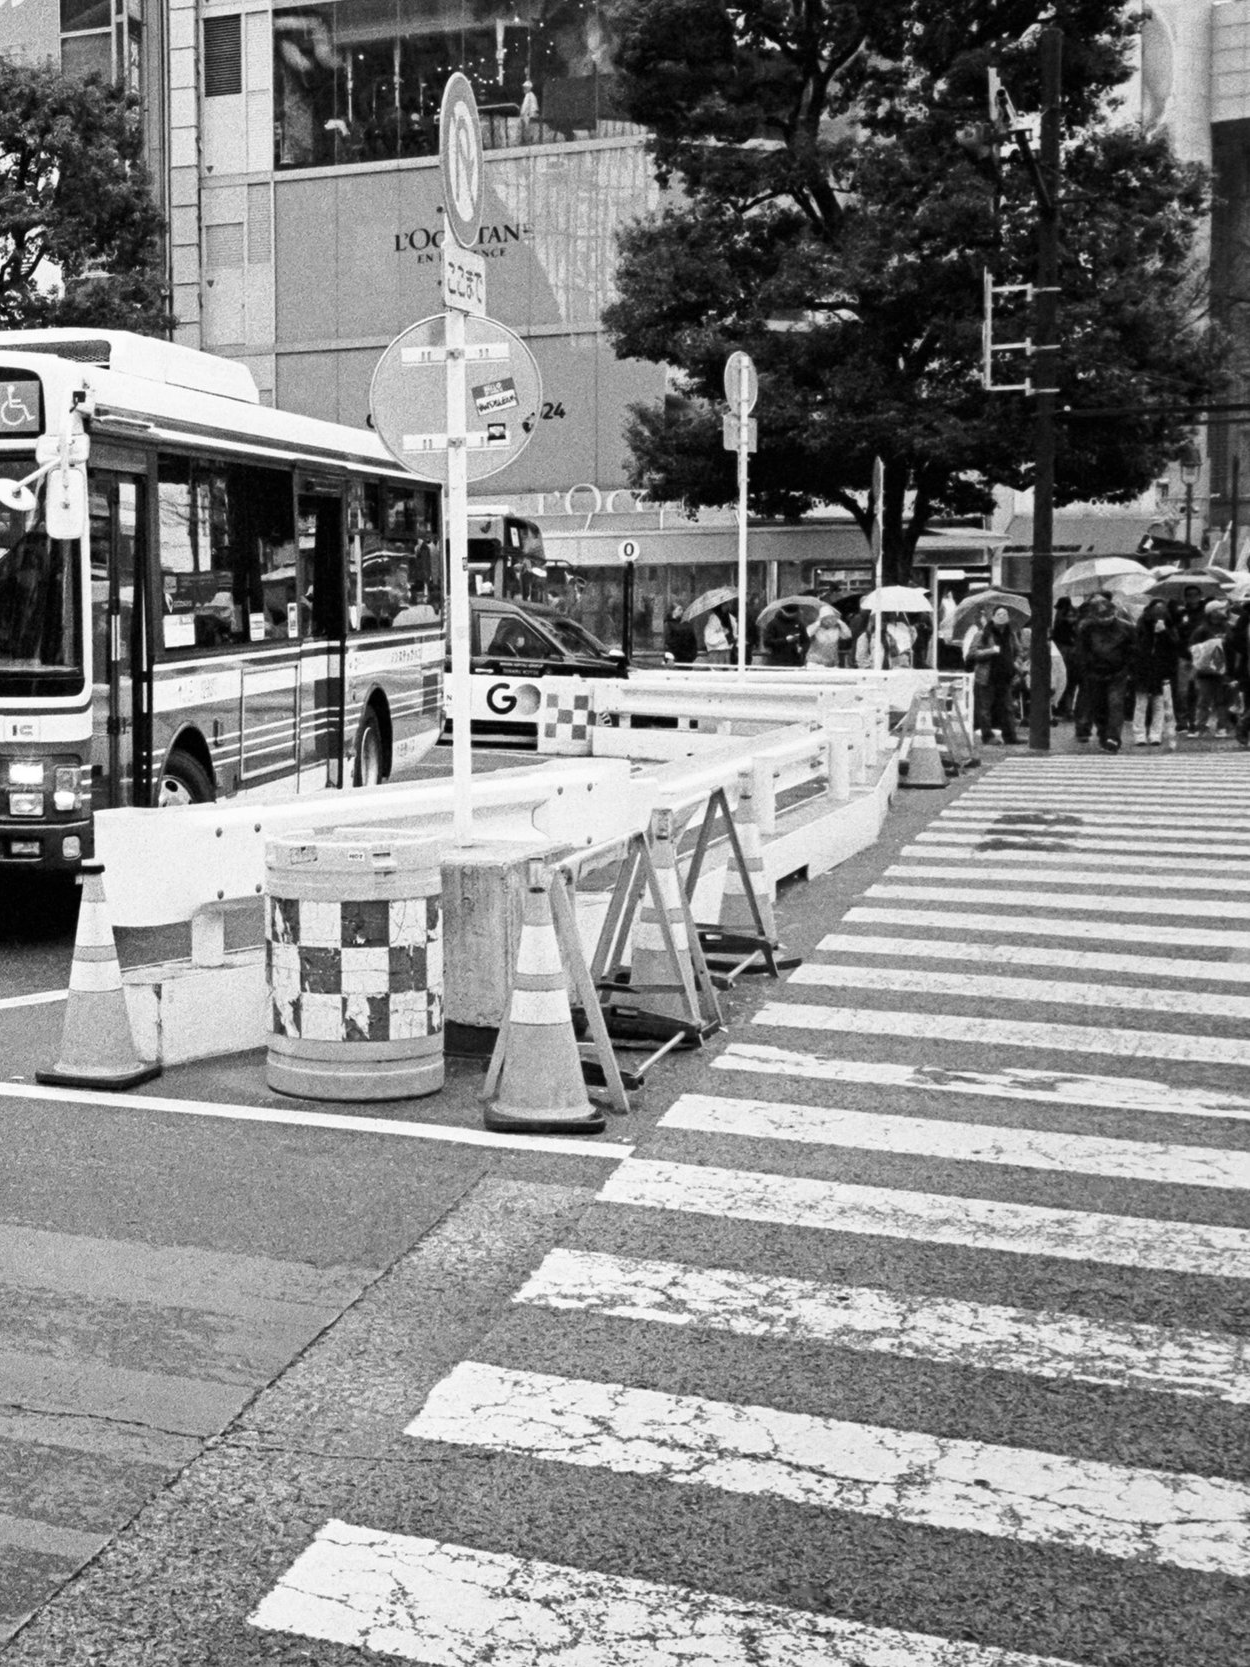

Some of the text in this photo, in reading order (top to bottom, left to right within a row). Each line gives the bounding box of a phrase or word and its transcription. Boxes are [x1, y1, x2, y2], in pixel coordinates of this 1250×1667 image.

[417, 254, 434, 264] EN
[448, 262, 483, 304] ここまで
